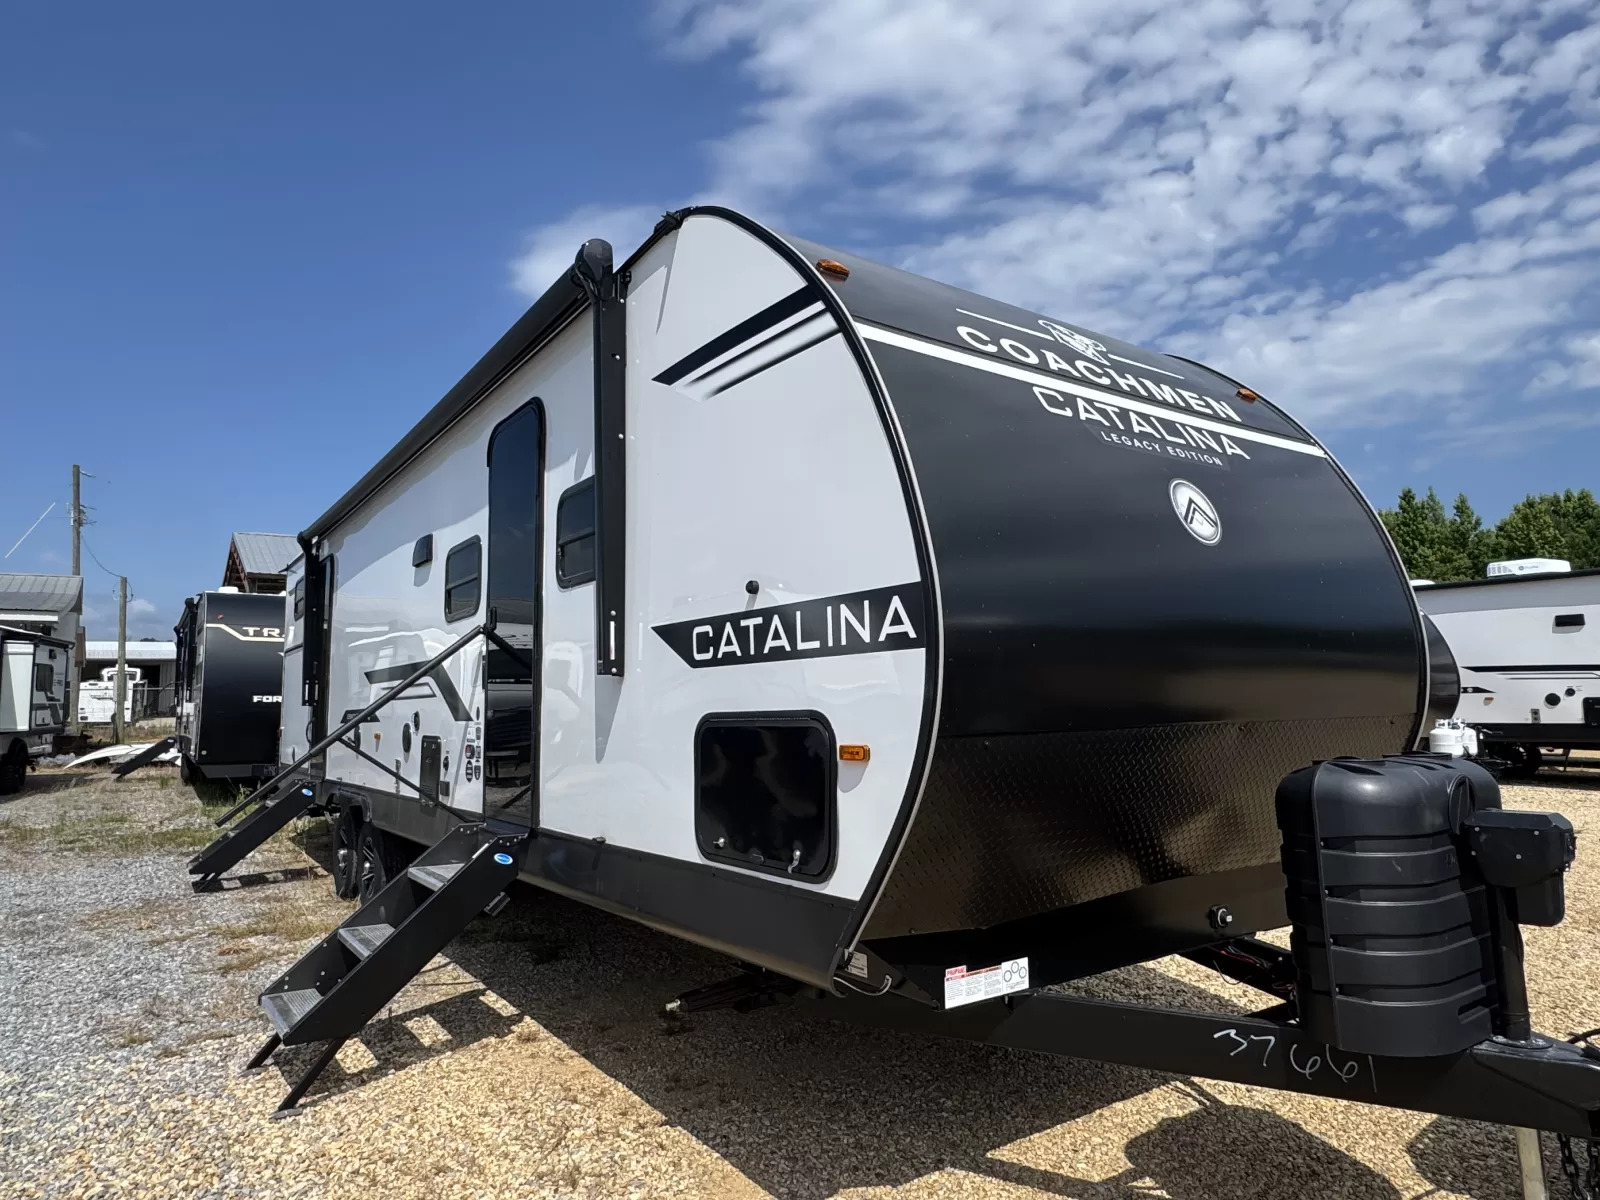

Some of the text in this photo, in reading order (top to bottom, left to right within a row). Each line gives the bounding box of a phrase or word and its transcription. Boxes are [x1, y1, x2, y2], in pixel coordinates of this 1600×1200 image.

[956, 325, 1242, 422] COACHMEN
[1032, 385, 1251, 461] CATALINA
[1100, 430, 1222, 467] LEGACY EDITION
[242, 626, 285, 637] TR
[692, 595, 918, 661] CATALINA
[1213, 1028, 1378, 1093] 37661
